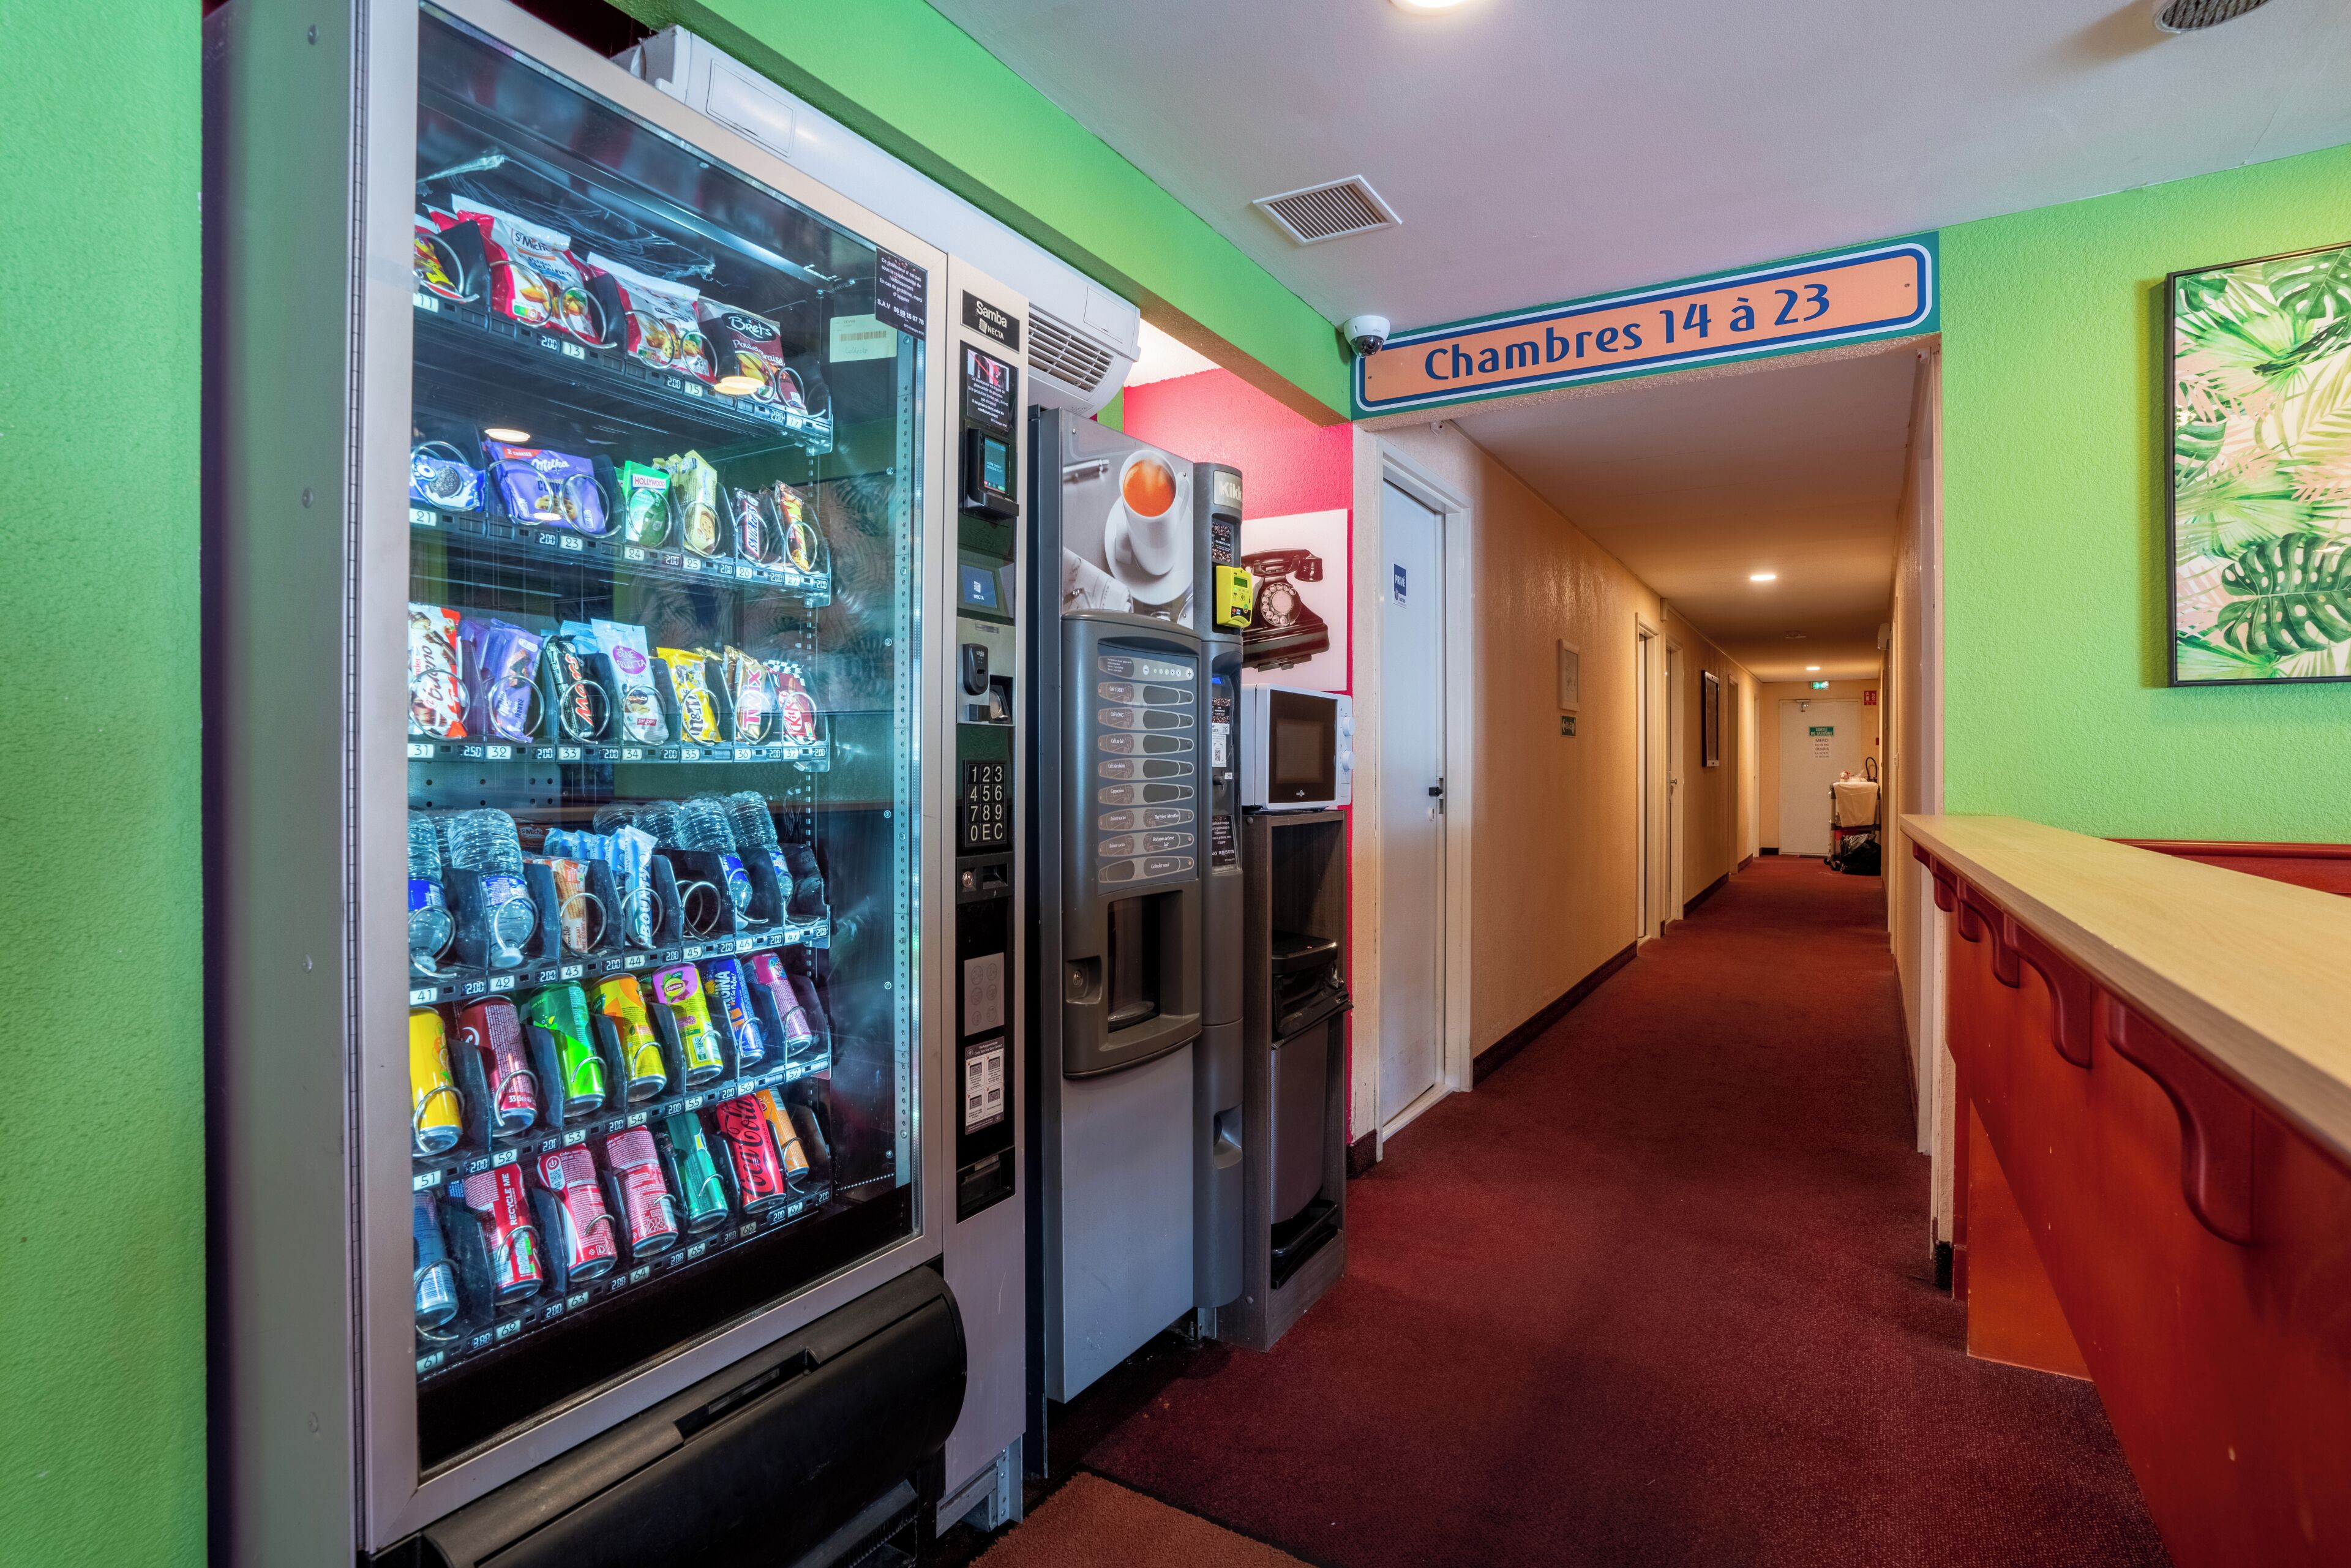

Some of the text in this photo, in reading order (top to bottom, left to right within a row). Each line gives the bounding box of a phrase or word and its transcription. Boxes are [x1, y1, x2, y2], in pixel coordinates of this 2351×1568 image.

[522, 235, 551, 252] Mich
[976, 300, 1008, 329] Samba
[728, 316, 773, 338] Brets
[987, 325, 1005, 340] NECTA
[1425, 283, 1831, 380] Chambres 14 à 23
[568, 343, 580, 356] 13
[689, 385, 700, 394] 15
[531, 458, 570, 473] Milka
[634, 477, 665, 487] HOLLYWOOD
[748, 505, 760, 552] SNICKERS
[565, 537, 579, 549] 23
[628, 548, 641, 559] 24
[687, 558, 699, 569] 25
[738, 568, 750, 577] 26
[1395, 574, 1405, 588] PRIVÉ
[564, 653, 594, 727] Mars
[416, 745, 429, 756] 31
[492, 746, 507, 757] 32
[563, 748, 577, 758] 33
[626, 749, 639, 759] 34
[684, 749, 697, 759] 35
[737, 749, 749, 759] 36
[972, 766, 1002, 782] 1 2 3
[970, 785, 1002, 802] 4 5 6
[970, 804, 1002, 822] 7 8 9
[970, 822, 1003, 841] 0 E C
[687, 947, 699, 958] 45
[628, 956, 642, 966] 44
[566, 966, 579, 976] 43
[495, 977, 511, 988] 42
[666, 983, 683, 992] Lipton
[418, 989, 432, 1001] 41
[789, 1069, 799, 1078] 57
[740, 1082, 751, 1092] 56
[688, 1097, 700, 1108] 55
[631, 1113, 643, 1124] 54
[568, 1131, 582, 1142] 53
[721, 1097, 776, 1198] Coca-Cola
[498, 1151, 513, 1165] 52
[421, 1174, 435, 1187] 51
[501, 1172, 518, 1226] RECYCLE ME
[791, 1204, 801, 1214] 67
[743, 1225, 754, 1235] 66
[691, 1245, 702, 1256] 65
[634, 1268, 647, 1281] 64
[571, 1293, 585, 1307] 63
[501, 1322, 516, 1336] 62
[424, 1352, 439, 1369] 61
